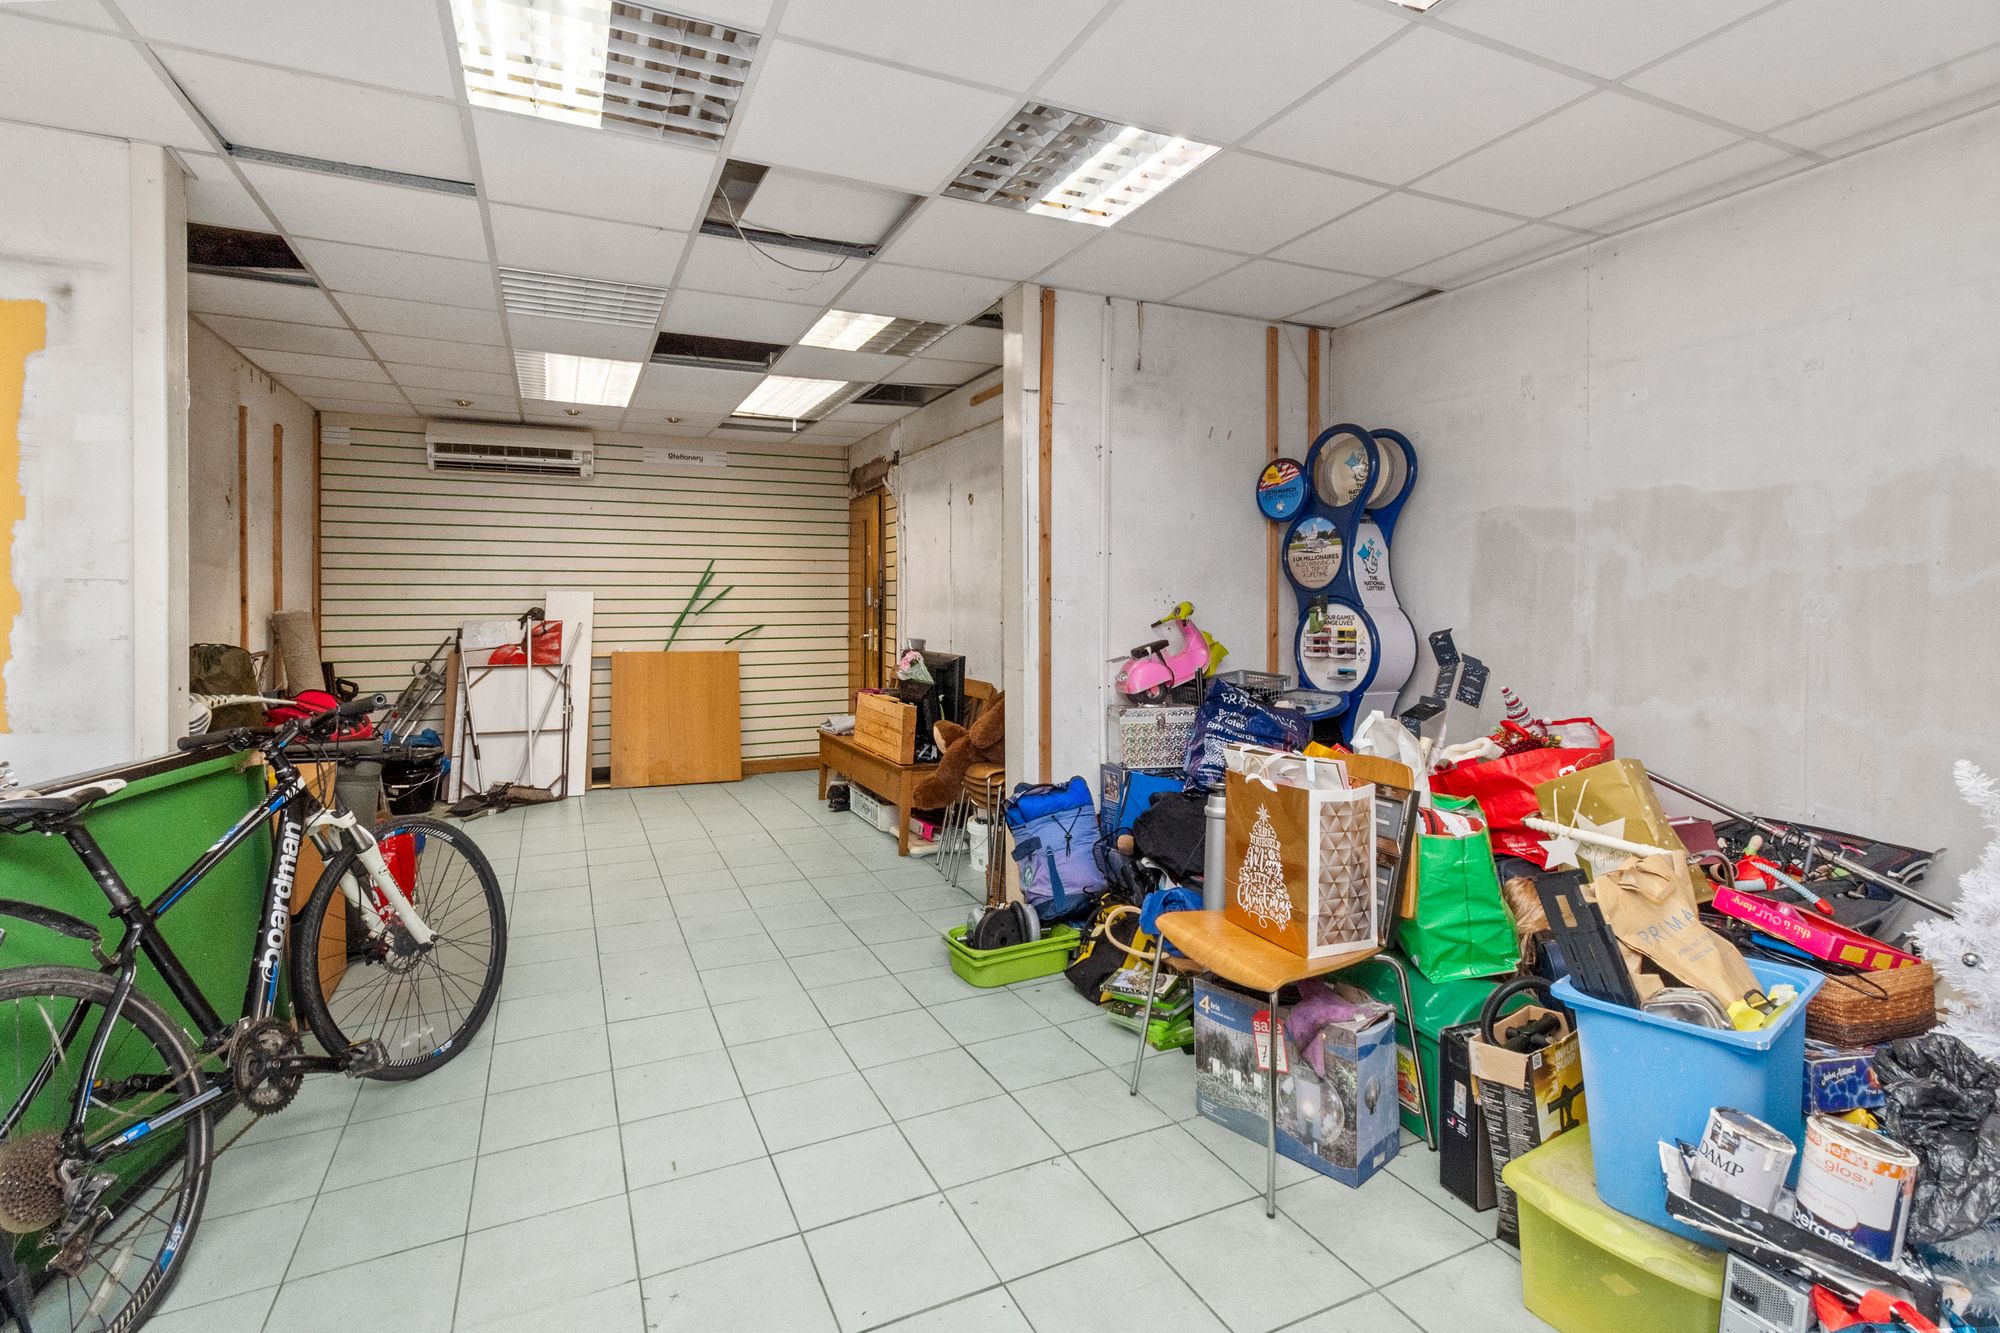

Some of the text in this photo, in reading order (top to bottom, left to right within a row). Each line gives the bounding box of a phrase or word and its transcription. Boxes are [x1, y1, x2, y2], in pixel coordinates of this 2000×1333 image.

[668, 452, 704, 463] Stationery
[1303, 553, 1339, 561] MILLIONAIRES
[259, 821, 302, 969] boardman
[1793, 924, 1813, 940] this
[1120, 986, 1147, 996] HALO
[1199, 995, 1220, 1014] 4 Iris
[1253, 1018, 1282, 1034] sae
[1821, 1071, 1836, 1086] John
[1699, 1139, 1744, 1177] DAMP
